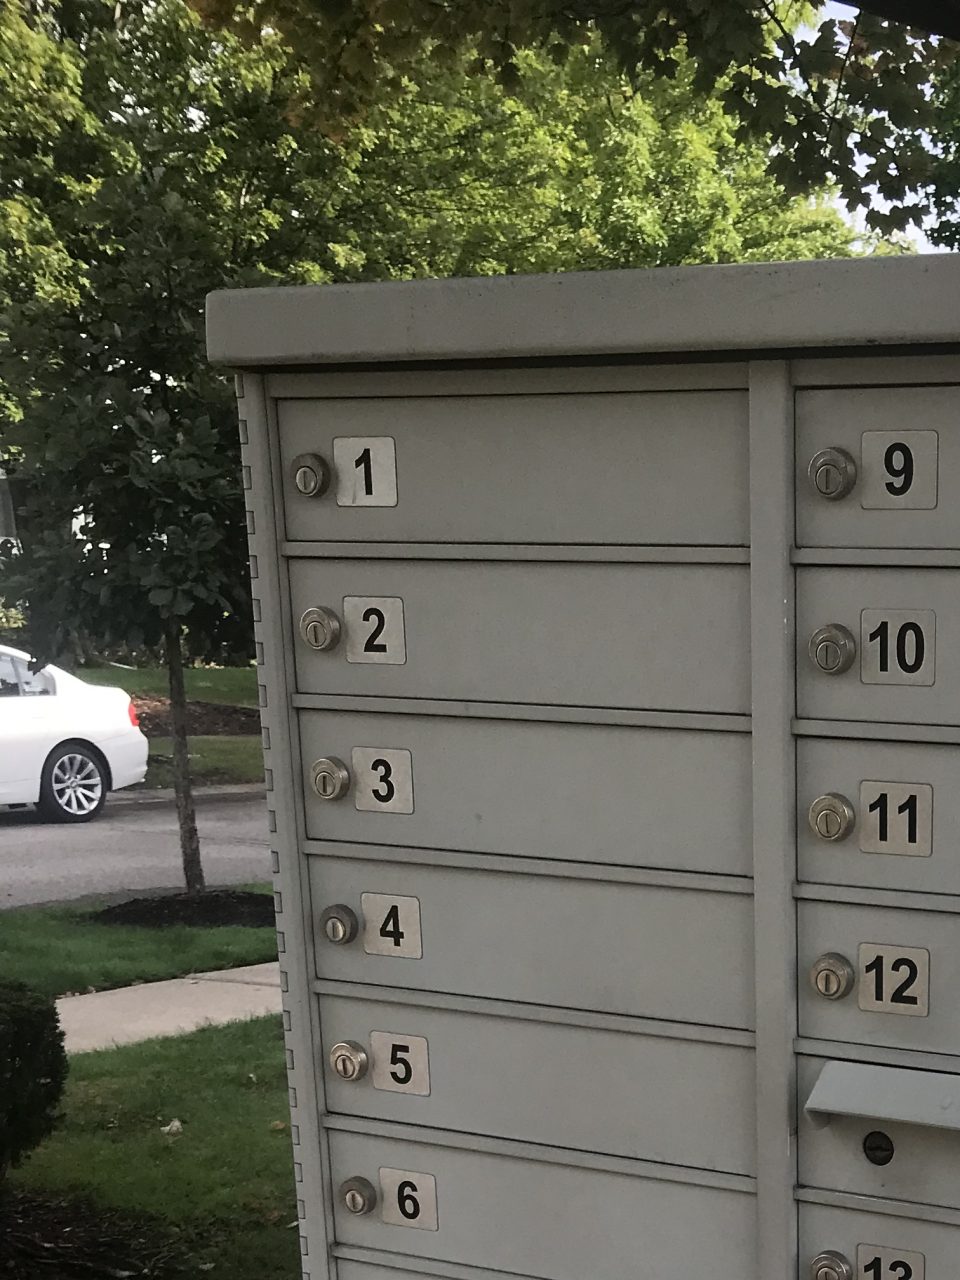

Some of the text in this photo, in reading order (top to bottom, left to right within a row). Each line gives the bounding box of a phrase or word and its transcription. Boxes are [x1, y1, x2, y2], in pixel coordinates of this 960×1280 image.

[354, 447, 373, 496] 1
[883, 442, 914, 497] 9
[362, 607, 388, 653] 2
[869, 621, 925, 674] 10
[370, 758, 395, 803] 3
[868, 792, 918, 844] 11
[379, 904, 405, 947] 4
[864, 955, 918, 1006] 12
[389, 1043, 413, 1085] 5
[397, 1180, 421, 1220] 6
